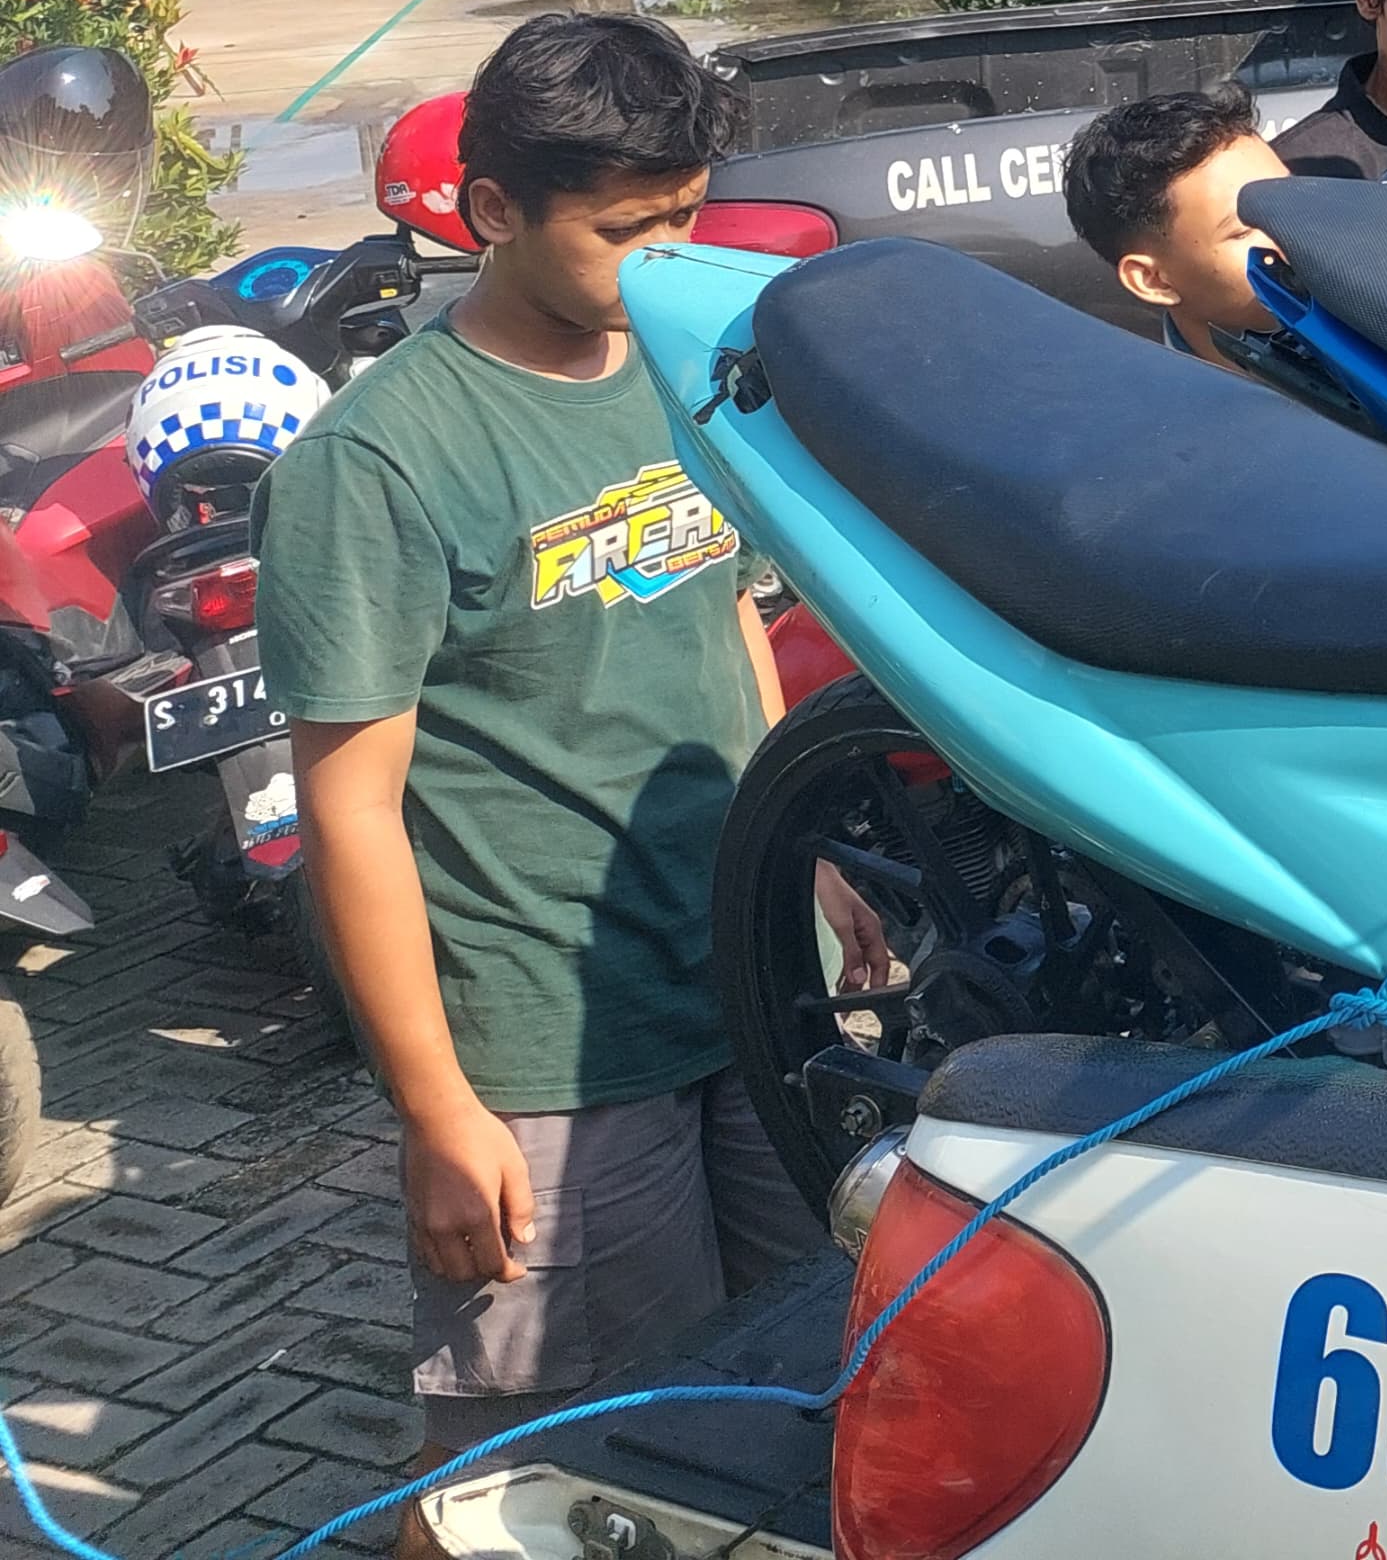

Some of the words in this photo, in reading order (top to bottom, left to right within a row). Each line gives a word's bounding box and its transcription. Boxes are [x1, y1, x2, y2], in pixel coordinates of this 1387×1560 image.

[887, 153, 992, 211] CALL
[140, 356, 261, 406] POLISI
[532, 499, 627, 549] PEMUDA
[154, 701, 175, 730] S
